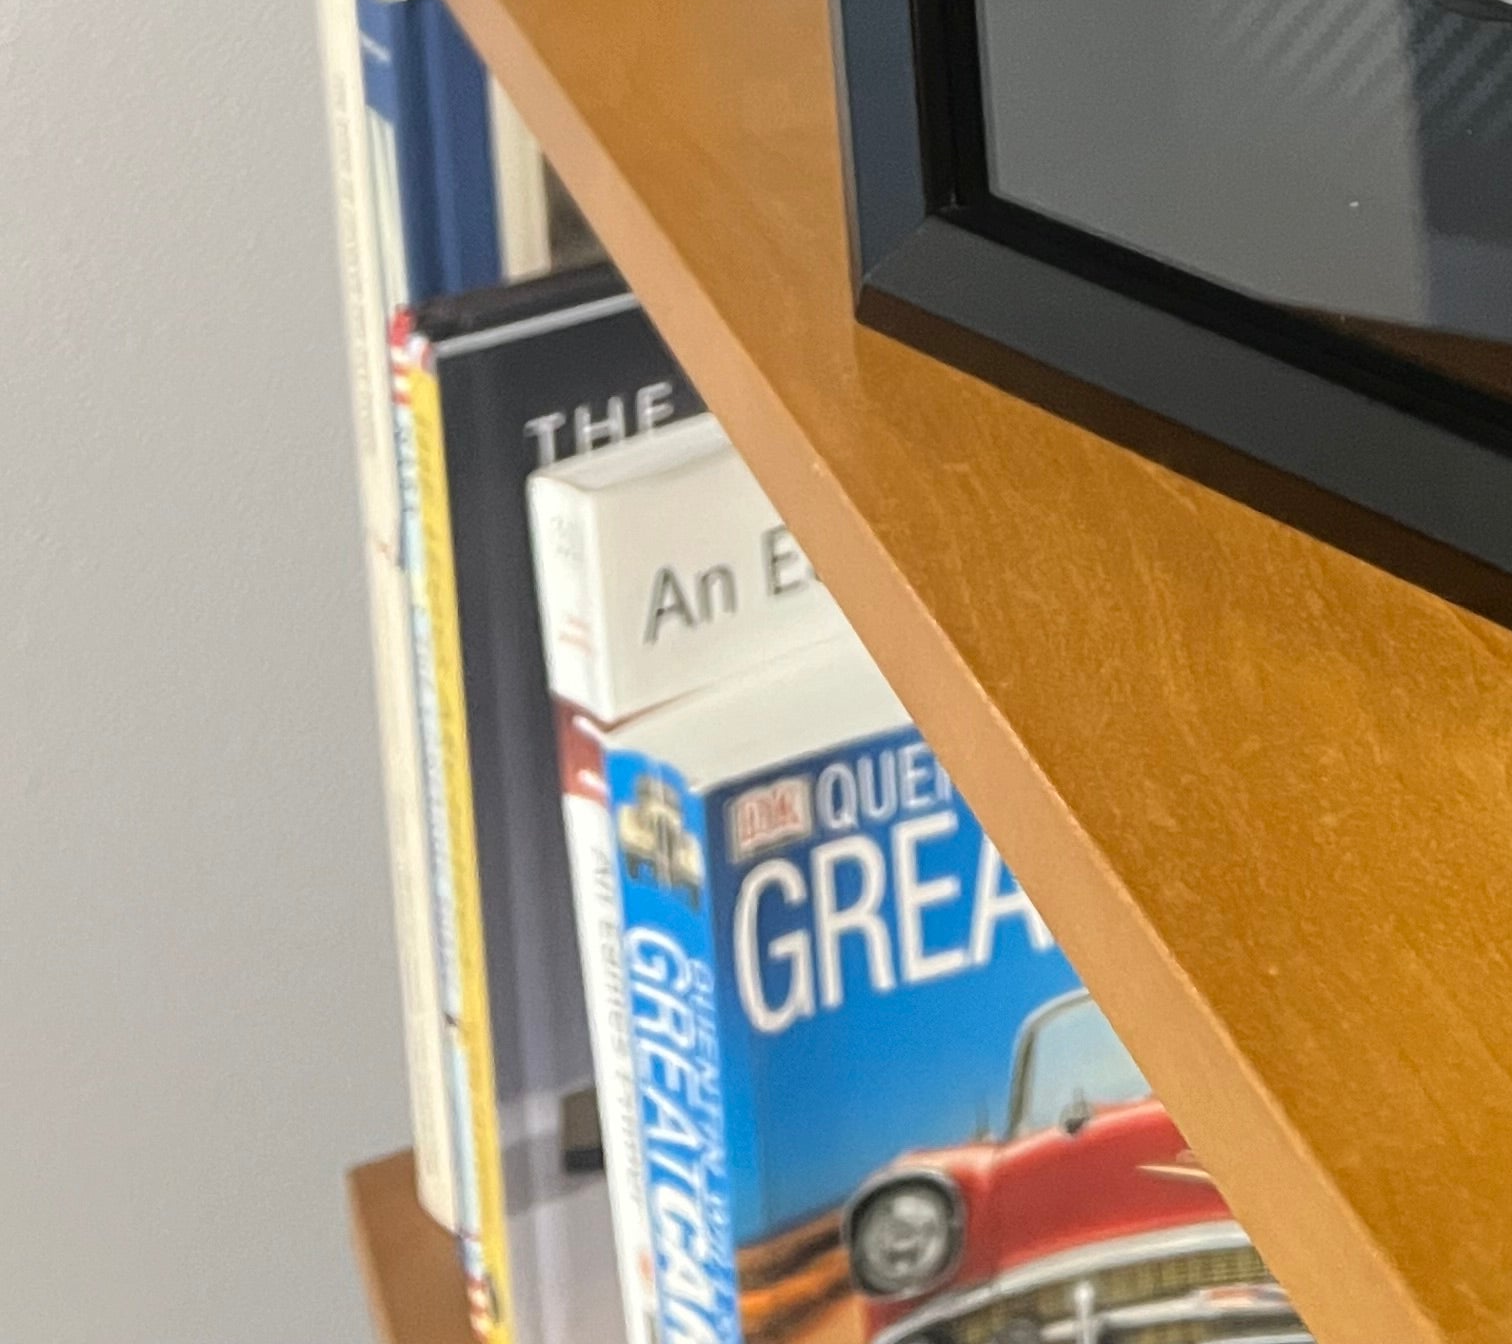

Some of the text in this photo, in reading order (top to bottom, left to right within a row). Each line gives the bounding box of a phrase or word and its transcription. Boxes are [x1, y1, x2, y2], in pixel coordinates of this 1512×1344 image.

[523, 381, 674, 466] THE
[642, 563, 738, 646] An
[759, 523, 822, 597] E
[732, 809, 1058, 1034] GREA
